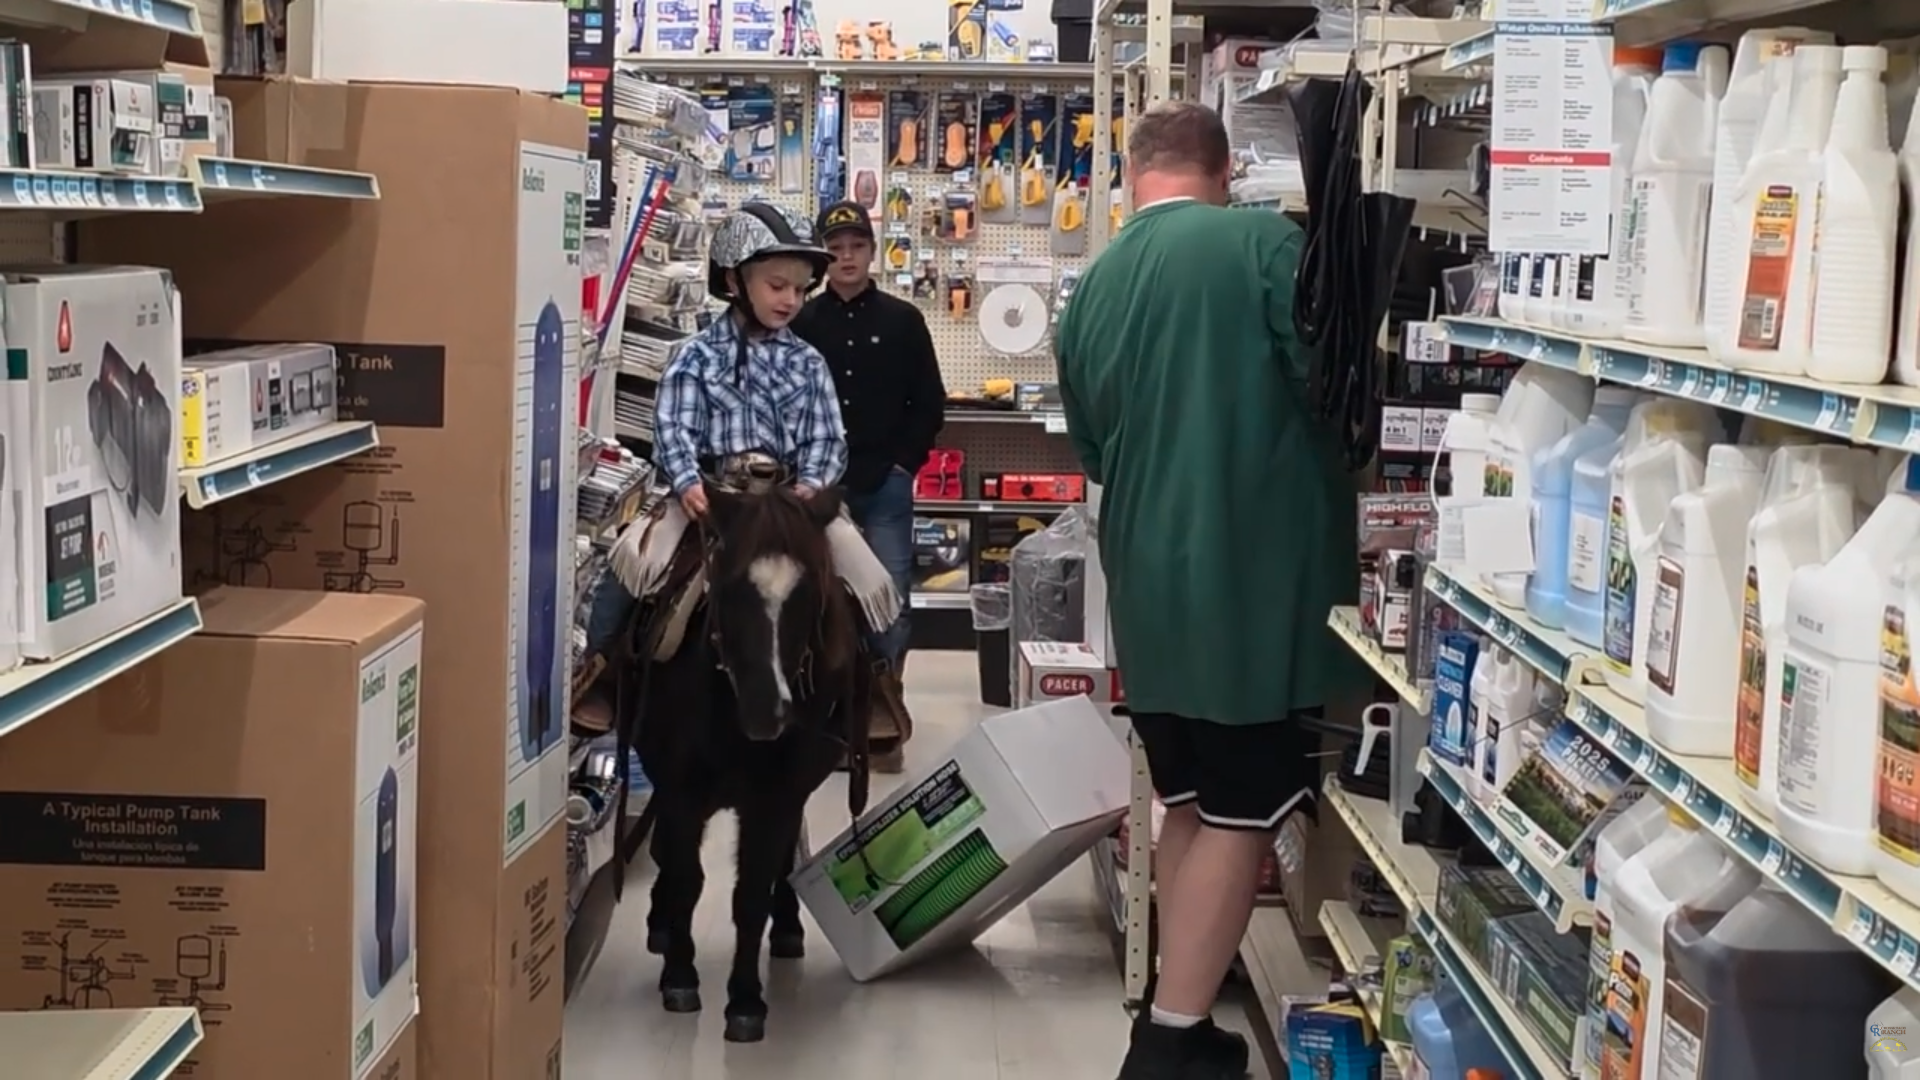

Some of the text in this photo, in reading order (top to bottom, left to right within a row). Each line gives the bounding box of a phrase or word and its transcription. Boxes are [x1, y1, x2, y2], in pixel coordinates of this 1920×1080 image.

[1498, 23, 1526, 33] Water
[1528, 23, 1561, 35] Quality
[1528, 153, 1574, 164] Colorants
[347, 353, 393, 370] Tank
[1046, 678, 1087, 691] PACER
[1570, 735, 1611, 772] 2025
[899, 777, 938, 812] SOLUTION
[936, 763, 958, 784] HOSE
[42, 802, 221, 822] A Typical Pump Tank
[84, 819, 178, 835] Installation
